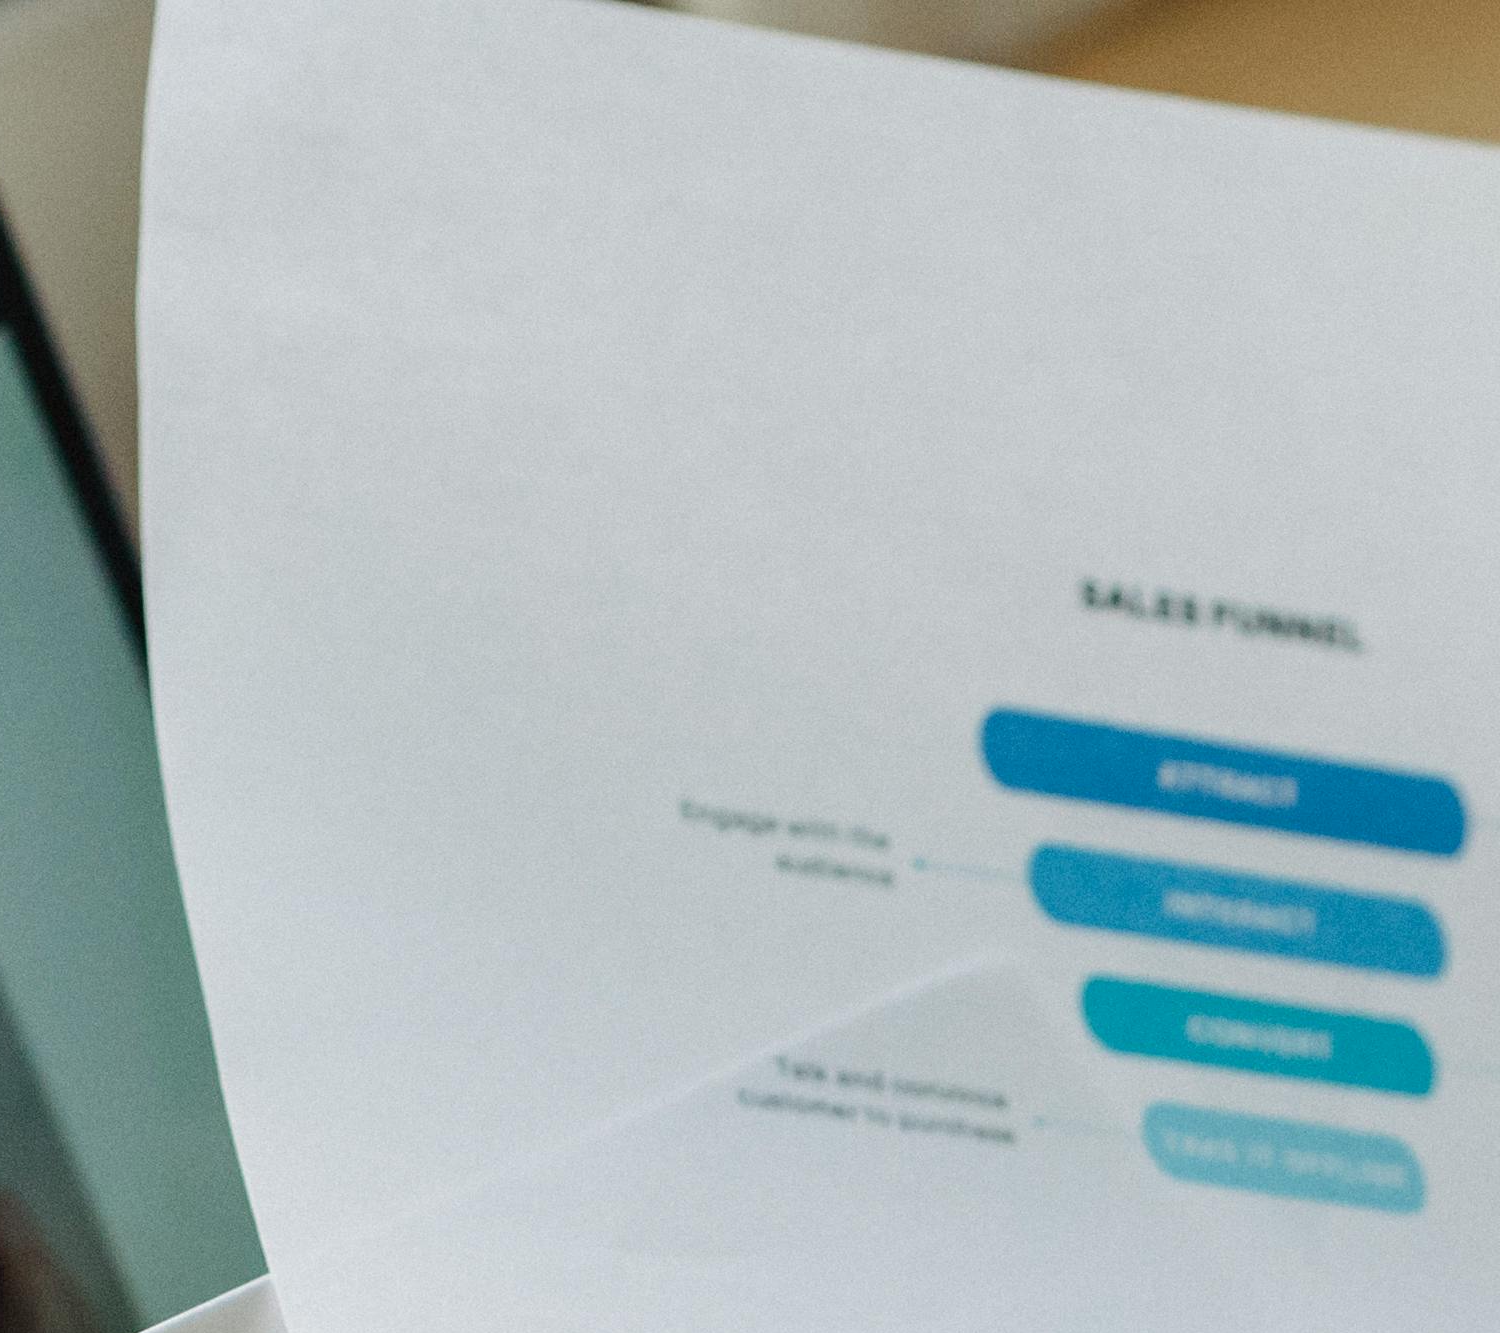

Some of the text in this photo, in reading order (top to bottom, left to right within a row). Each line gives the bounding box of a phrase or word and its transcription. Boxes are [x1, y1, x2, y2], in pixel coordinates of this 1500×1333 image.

[1078, 574, 1364, 655] SALES FUNNEL
[1157, 759, 1299, 808] ATTRACT
